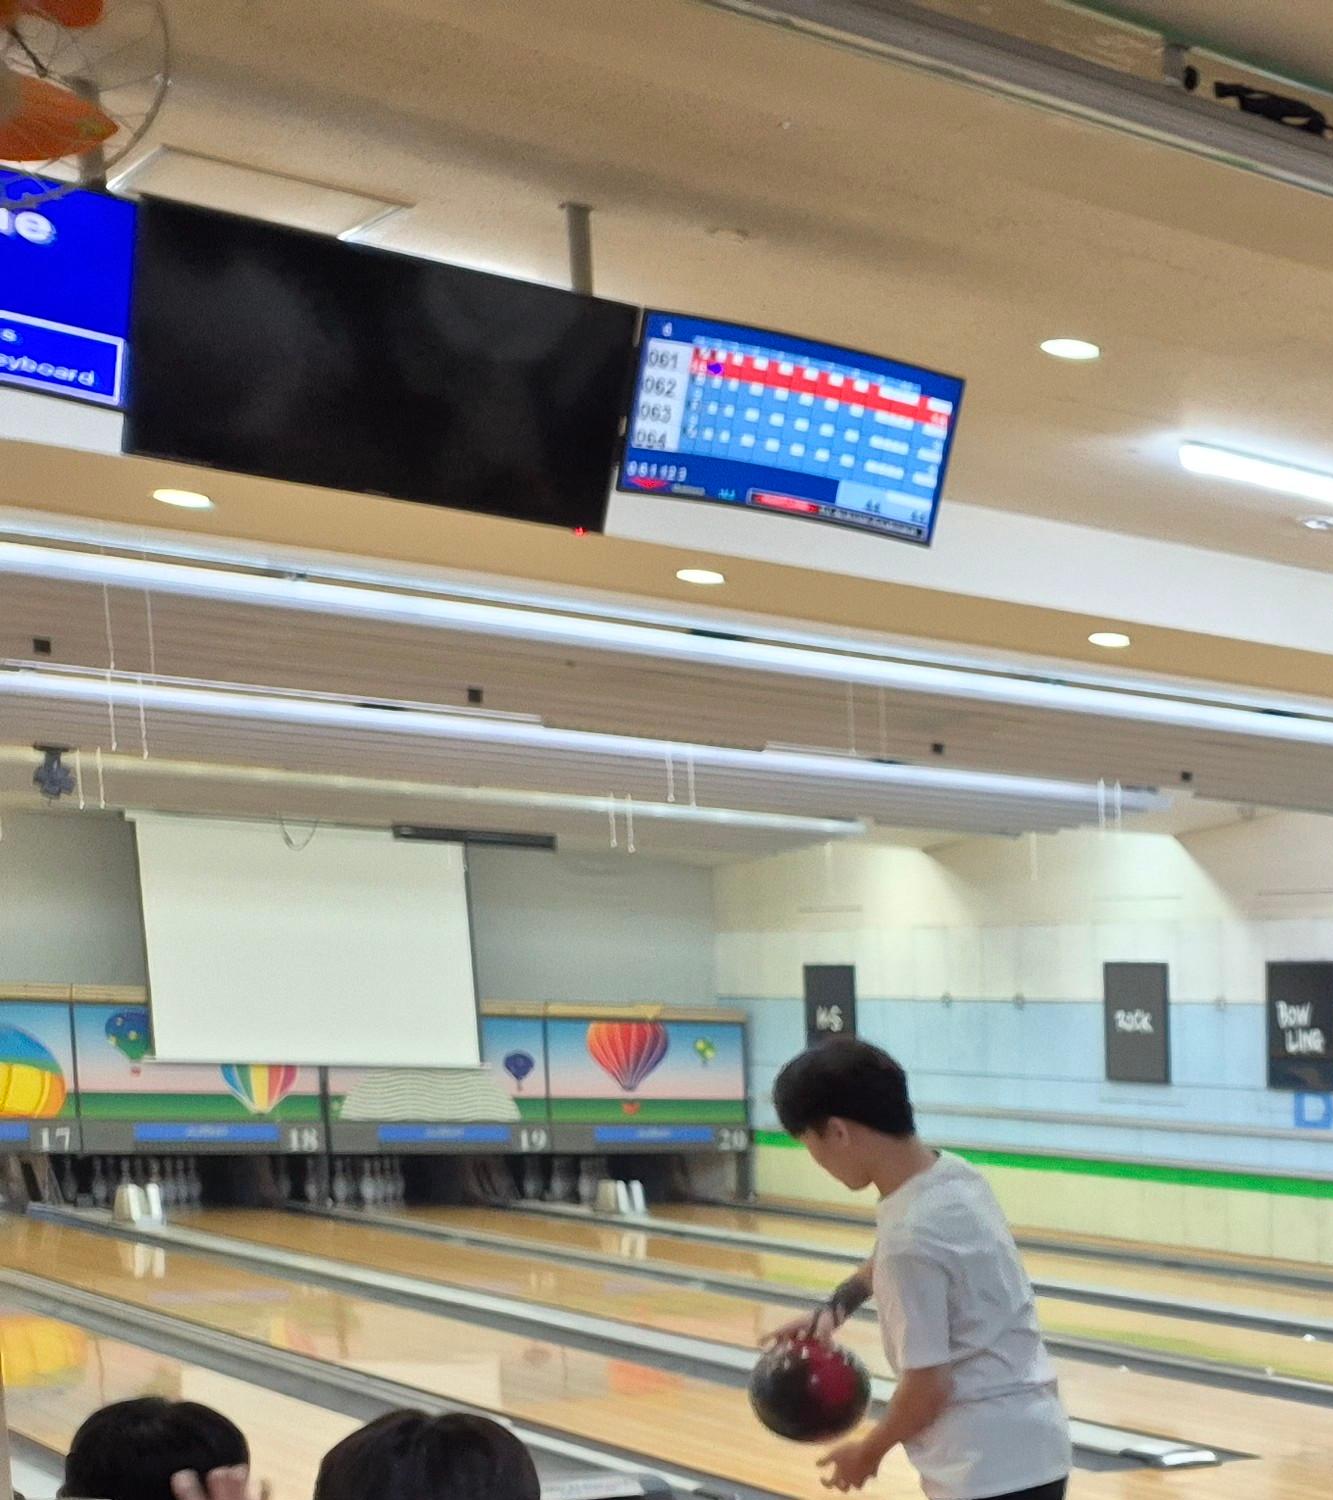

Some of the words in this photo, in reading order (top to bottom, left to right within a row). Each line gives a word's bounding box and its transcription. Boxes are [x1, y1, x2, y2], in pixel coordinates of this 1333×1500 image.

[649, 350, 679, 369] 061
[644, 376, 677, 397] 062
[640, 404, 672, 423] 063
[636, 430, 668, 449] 064
[1275, 1000, 1313, 1030] BOW
[1285, 1029, 1326, 1054] LING
[39, 1127, 71, 1152] 17
[288, 1127, 319, 1152] 18
[520, 1129, 547, 1152] 19
[717, 1128, 746, 1150] 20
